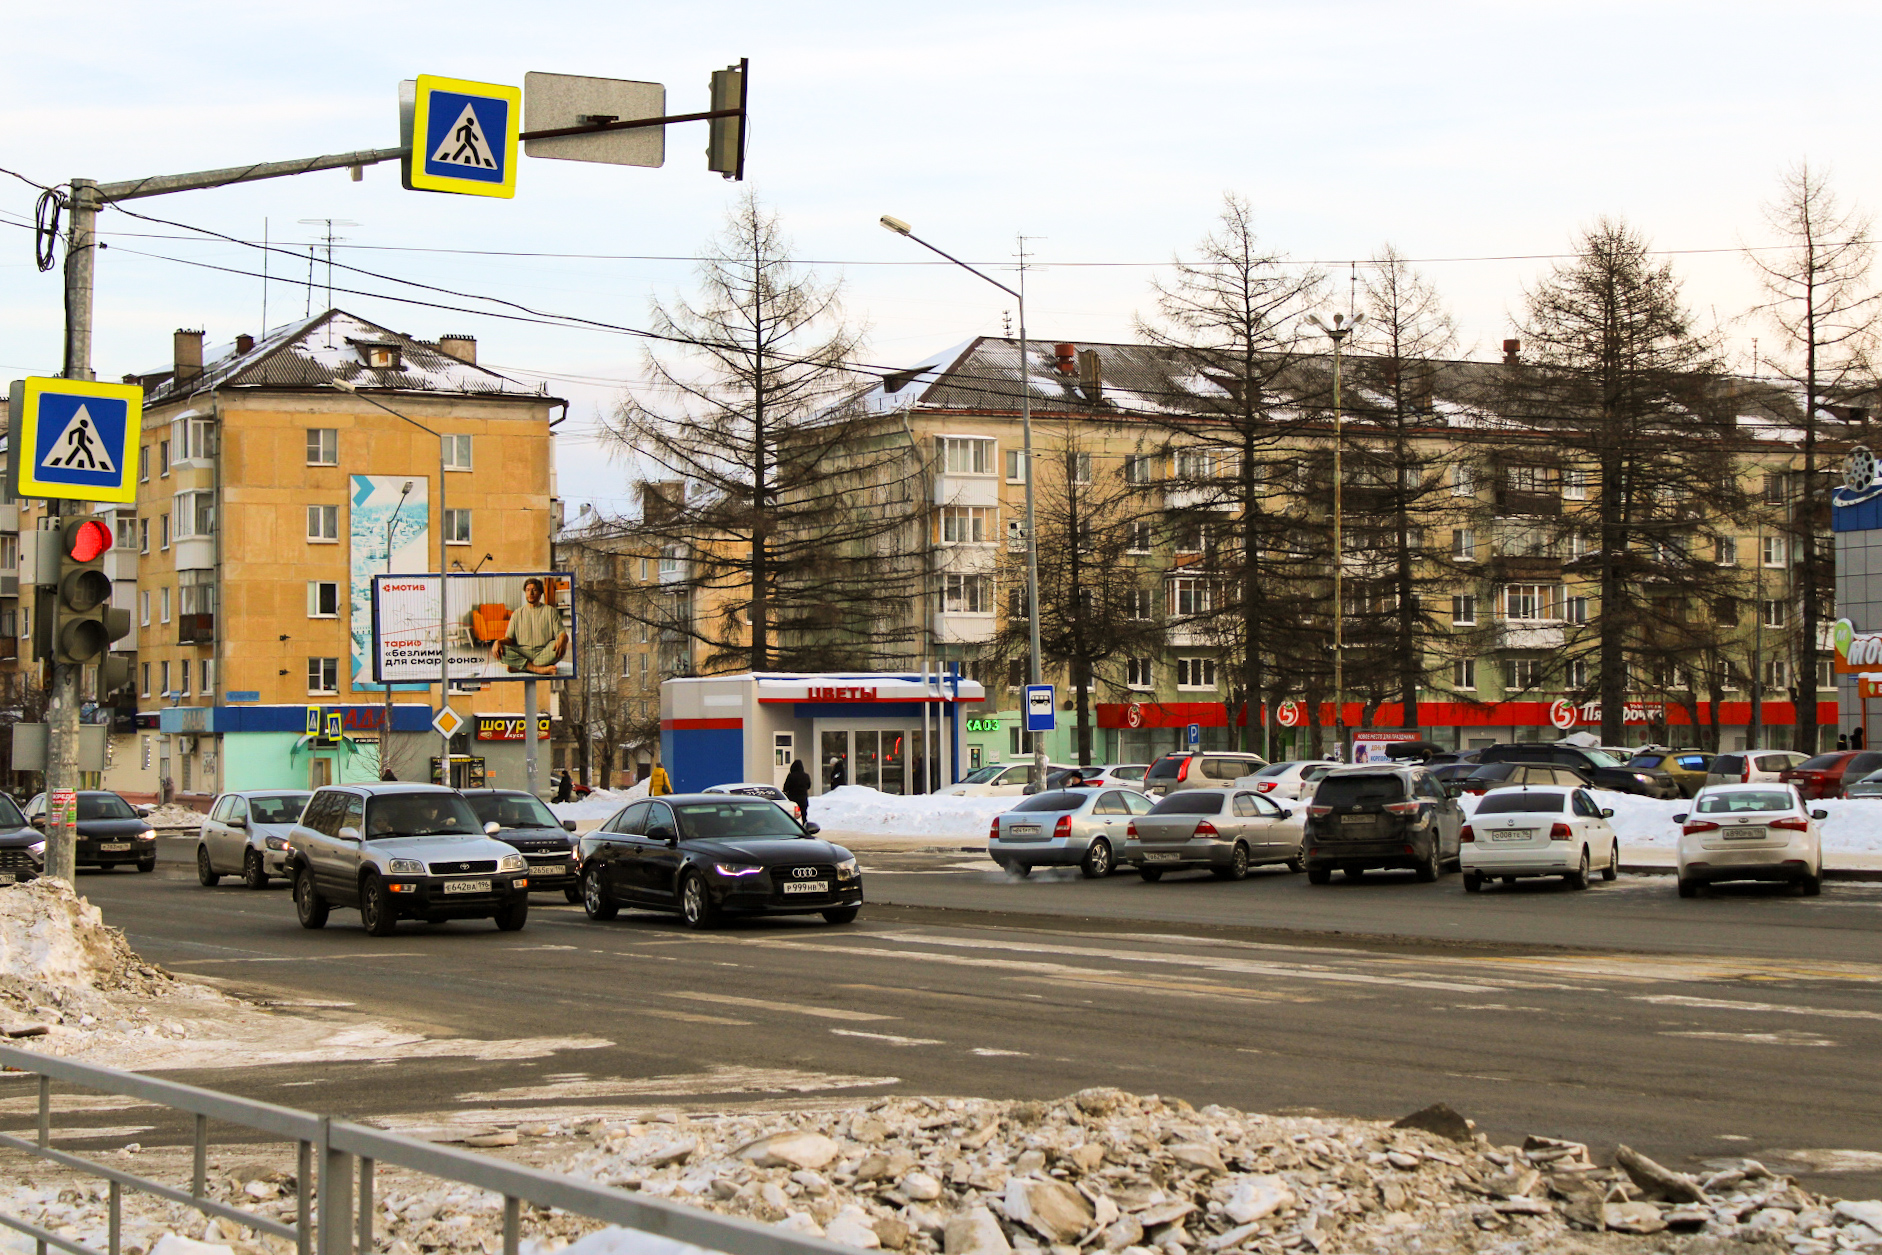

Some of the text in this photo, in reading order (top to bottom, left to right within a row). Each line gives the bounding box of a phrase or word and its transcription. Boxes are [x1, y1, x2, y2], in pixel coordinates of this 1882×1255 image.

[391, 584, 426, 592] МОТИВ
[384, 640, 422, 648] тариф
[385, 649, 444, 657] «безлими
[1847, 638, 1882, 665] МО
[385, 657, 485, 667] для смарфона»
[808, 686, 877, 701] ЦВЕТЫ
[480, 719, 550, 738] шаура
